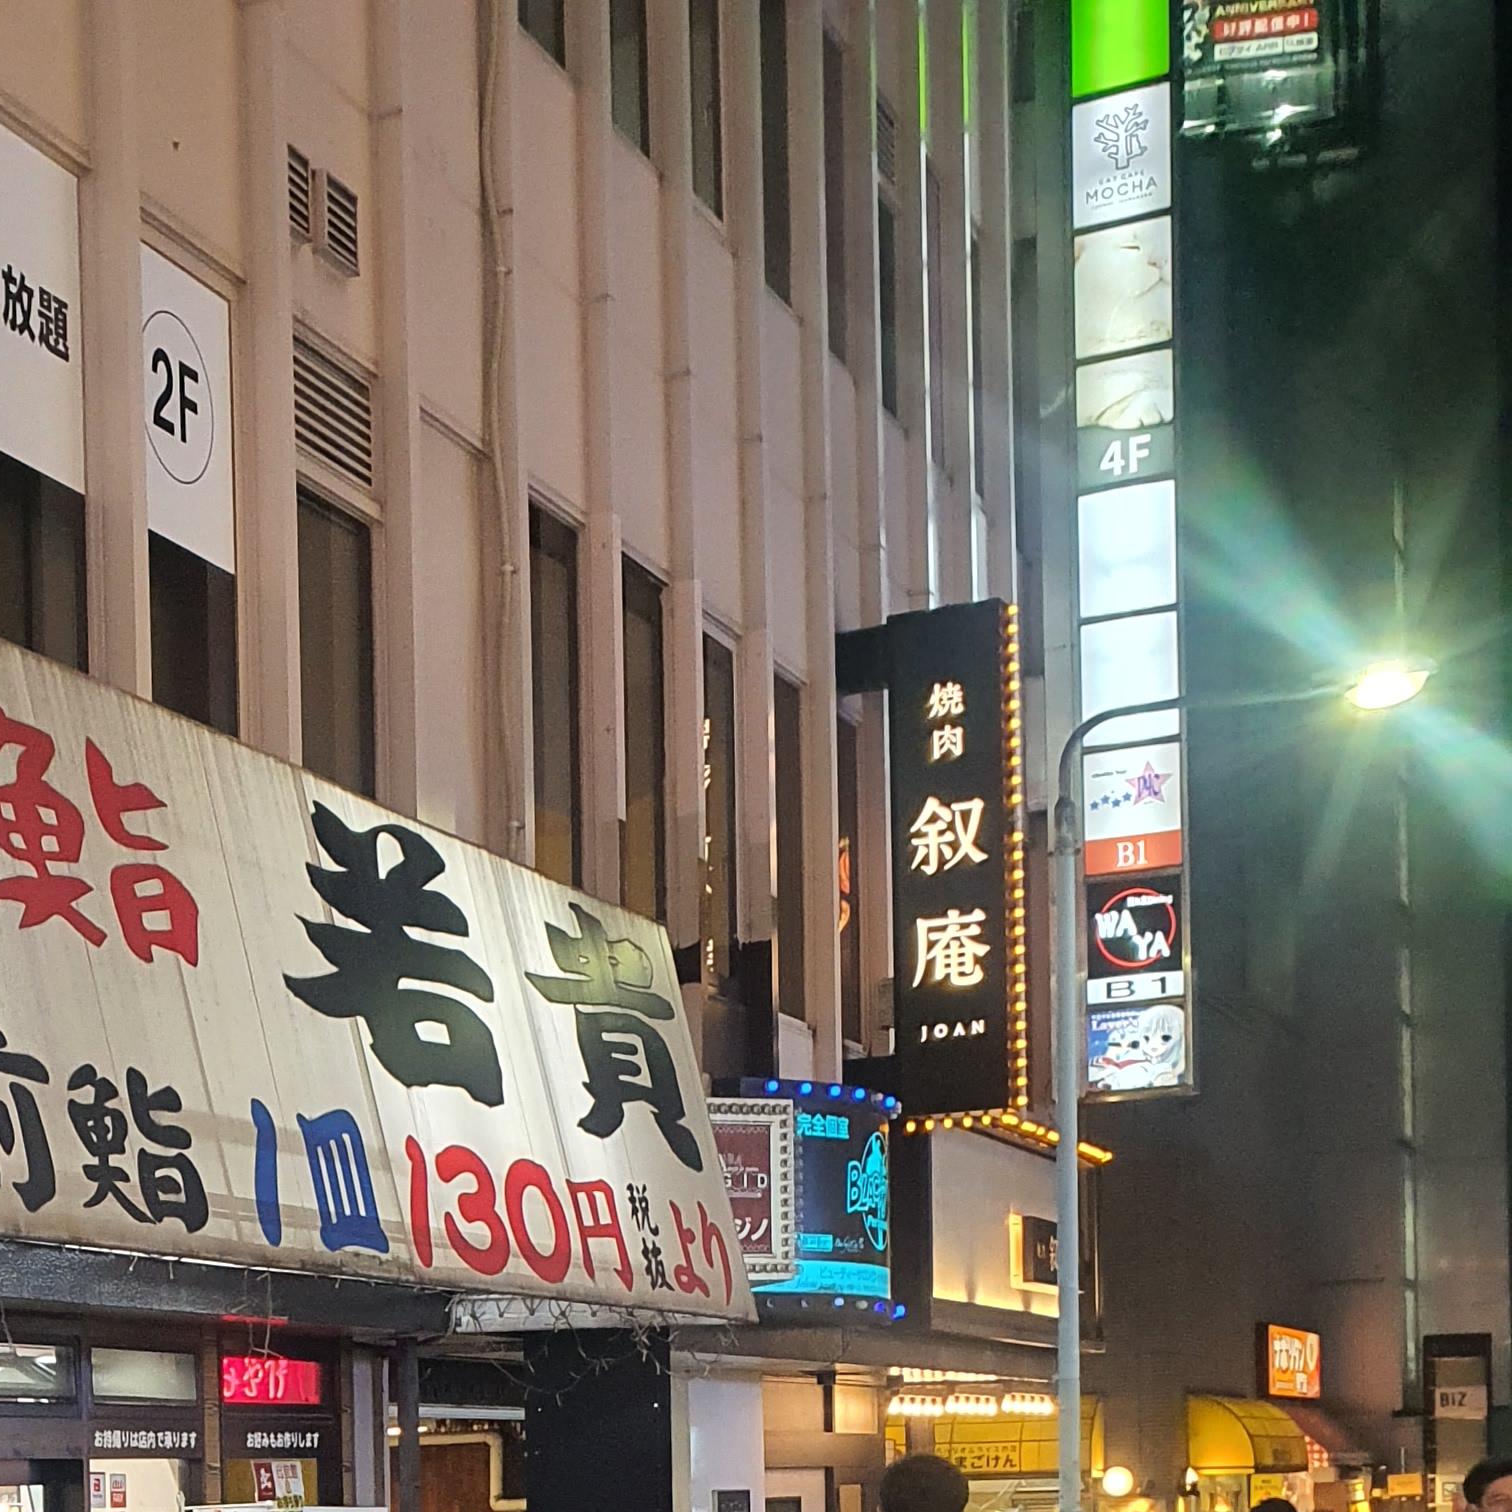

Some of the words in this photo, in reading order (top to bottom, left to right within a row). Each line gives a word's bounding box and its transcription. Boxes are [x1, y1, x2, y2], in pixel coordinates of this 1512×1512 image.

[1085, 176, 1158, 204] MOCHA
[149, 346, 202, 444] 2F
[1099, 433, 1152, 476] 4F
[928, 680, 965, 761] 焼肉
[1115, 839, 1149, 868] B1
[909, 794, 991, 991] 叙庵
[1095, 909, 1138, 939] WA
[1132, 931, 1171, 960] YA
[282, 799, 703, 1174] 若貴
[920, 1019, 986, 1044] JOAN
